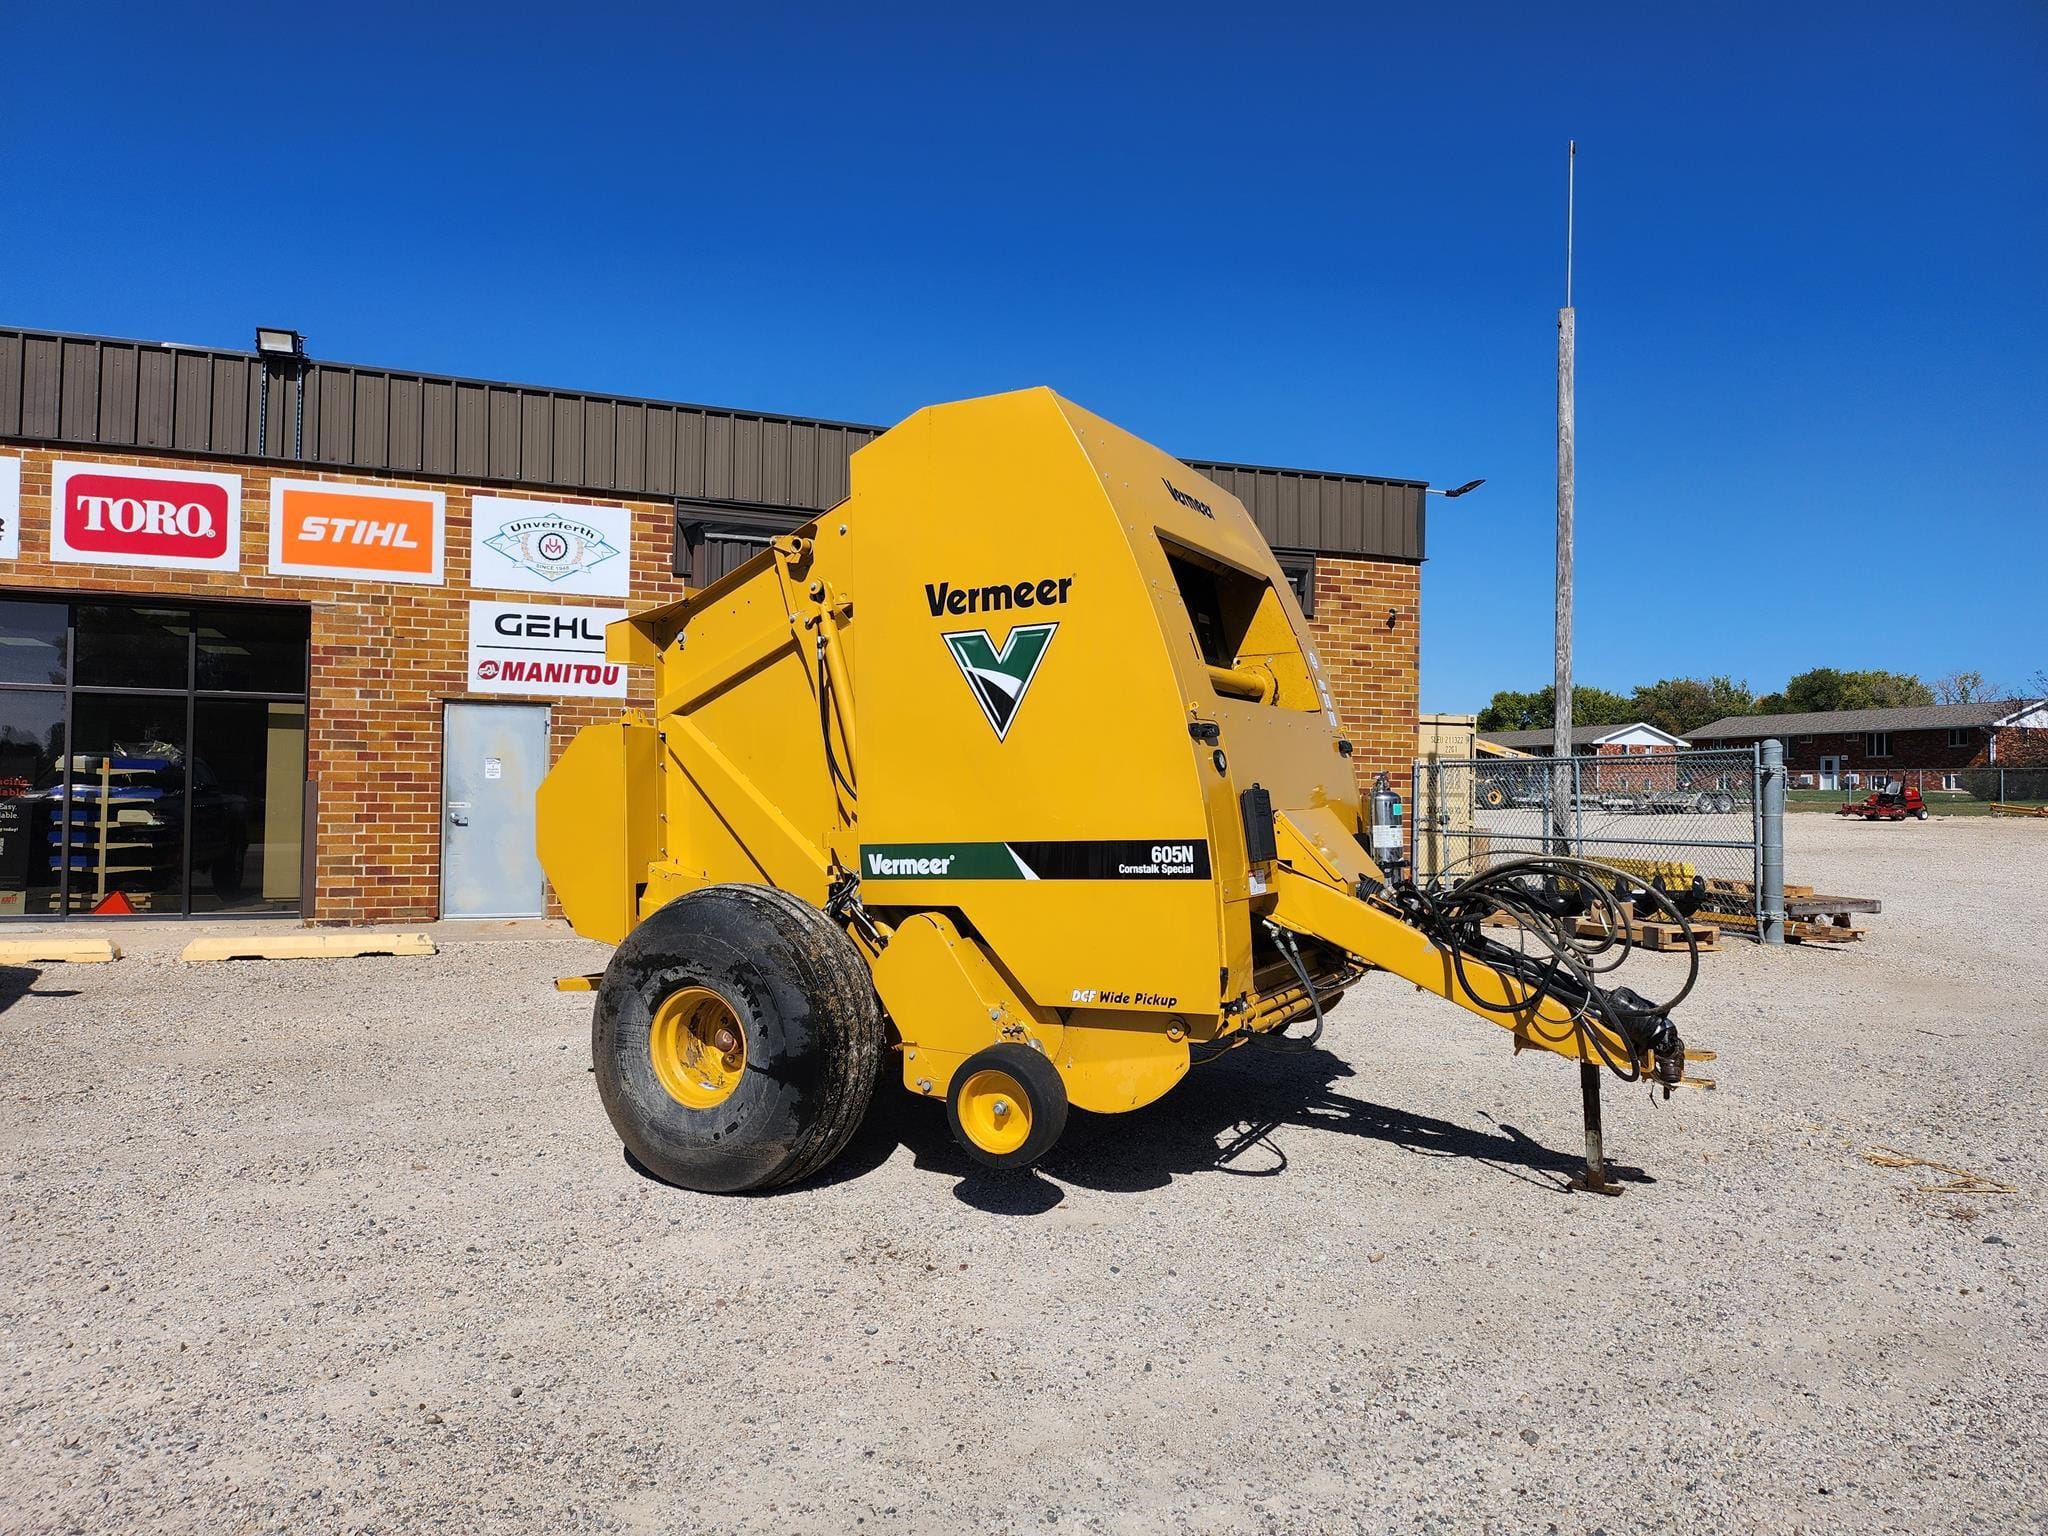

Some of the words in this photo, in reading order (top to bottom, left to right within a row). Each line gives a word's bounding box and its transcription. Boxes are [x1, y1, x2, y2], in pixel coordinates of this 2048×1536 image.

[1161, 477, 1215, 520] Vermeer
[77, 495, 212, 538] TORO
[298, 516, 418, 548] STIHL
[510, 522, 595, 539] Unverferth
[925, 578, 1072, 617] Vermeer
[495, 613, 604, 641] GEHL
[501, 661, 619, 686] MANITOU
[868, 853, 951, 875] Vermeer
[1151, 845, 1194, 864] 605N
[1118, 863, 1160, 874] Cornstalk
[1161, 863, 1194, 875] Special
[1071, 989, 1097, 1002] DCF
[1099, 990, 1130, 1004] Wide
[1134, 992, 1178, 1008] Pickup
